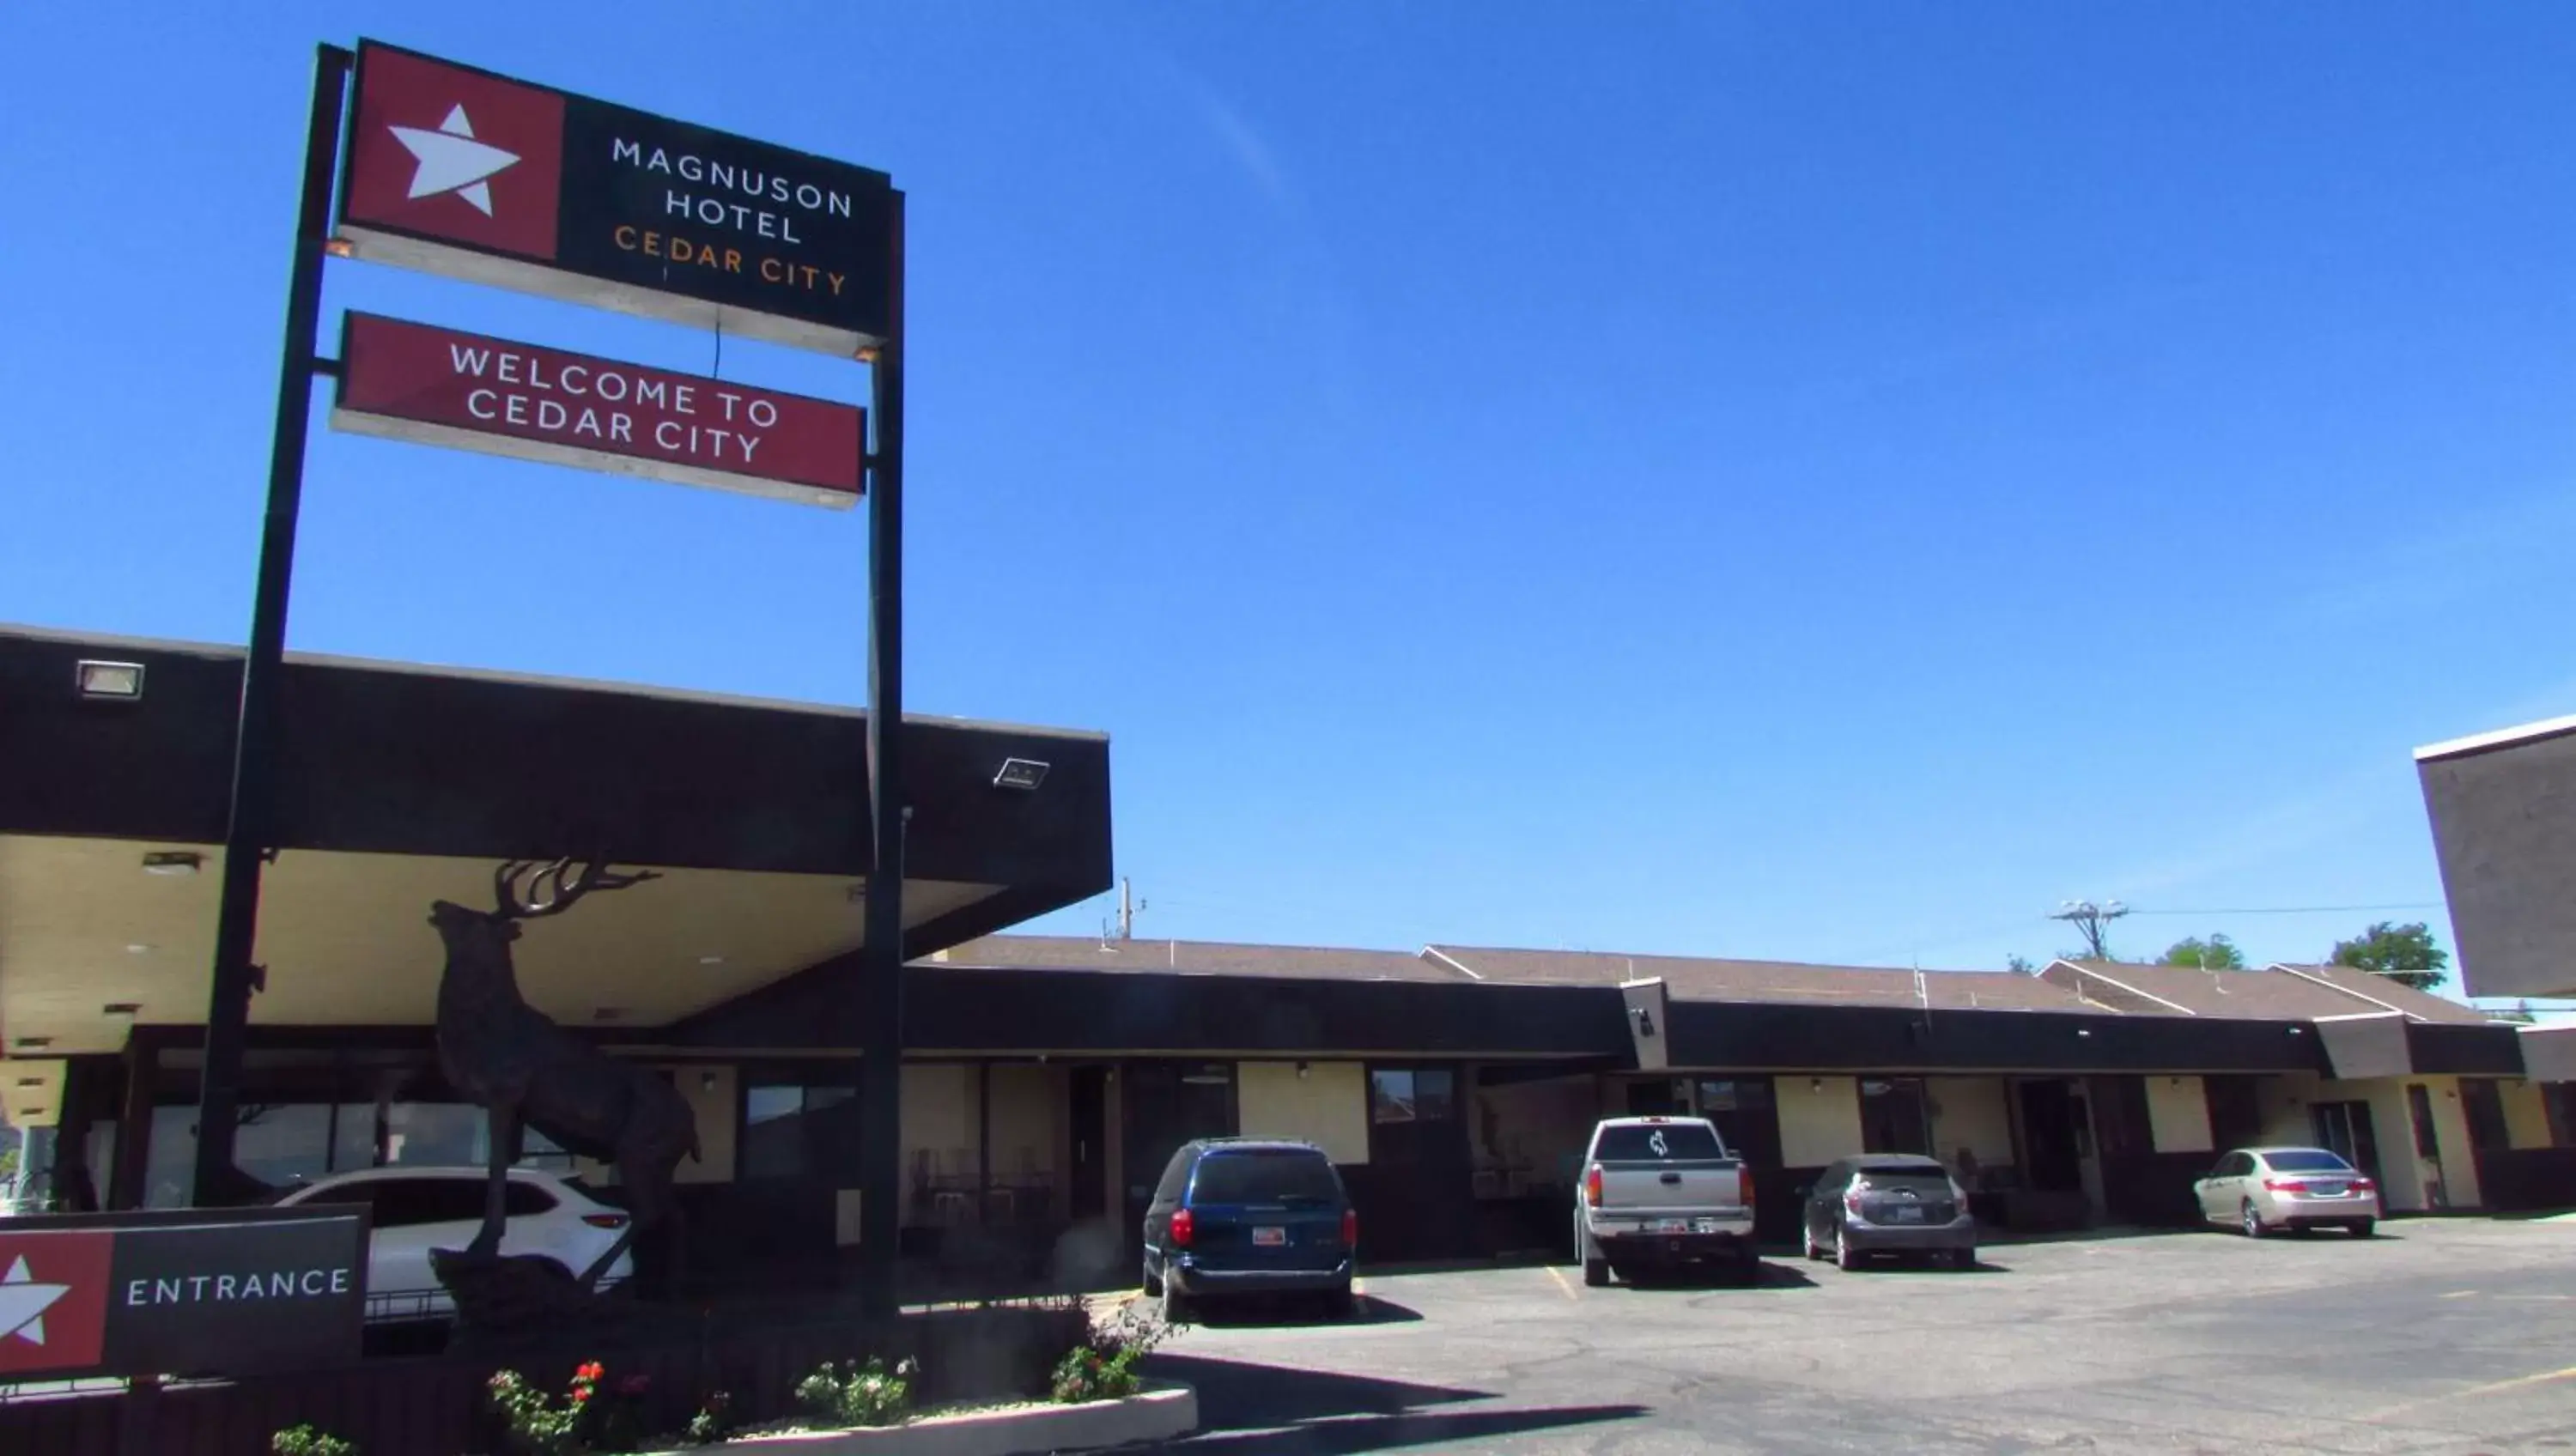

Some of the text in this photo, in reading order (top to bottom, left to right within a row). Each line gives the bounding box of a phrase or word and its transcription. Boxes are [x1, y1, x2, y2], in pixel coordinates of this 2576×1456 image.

[612, 137, 852, 218] MAGNUSON
[665, 190, 801, 244] HOTEL
[615, 226, 846, 296] CEDAR CITY
[450, 343, 777, 428] WELCOME TO
[467, 390, 760, 463] CEDAR CITY
[128, 1269, 349, 1306] ENTRANCE
